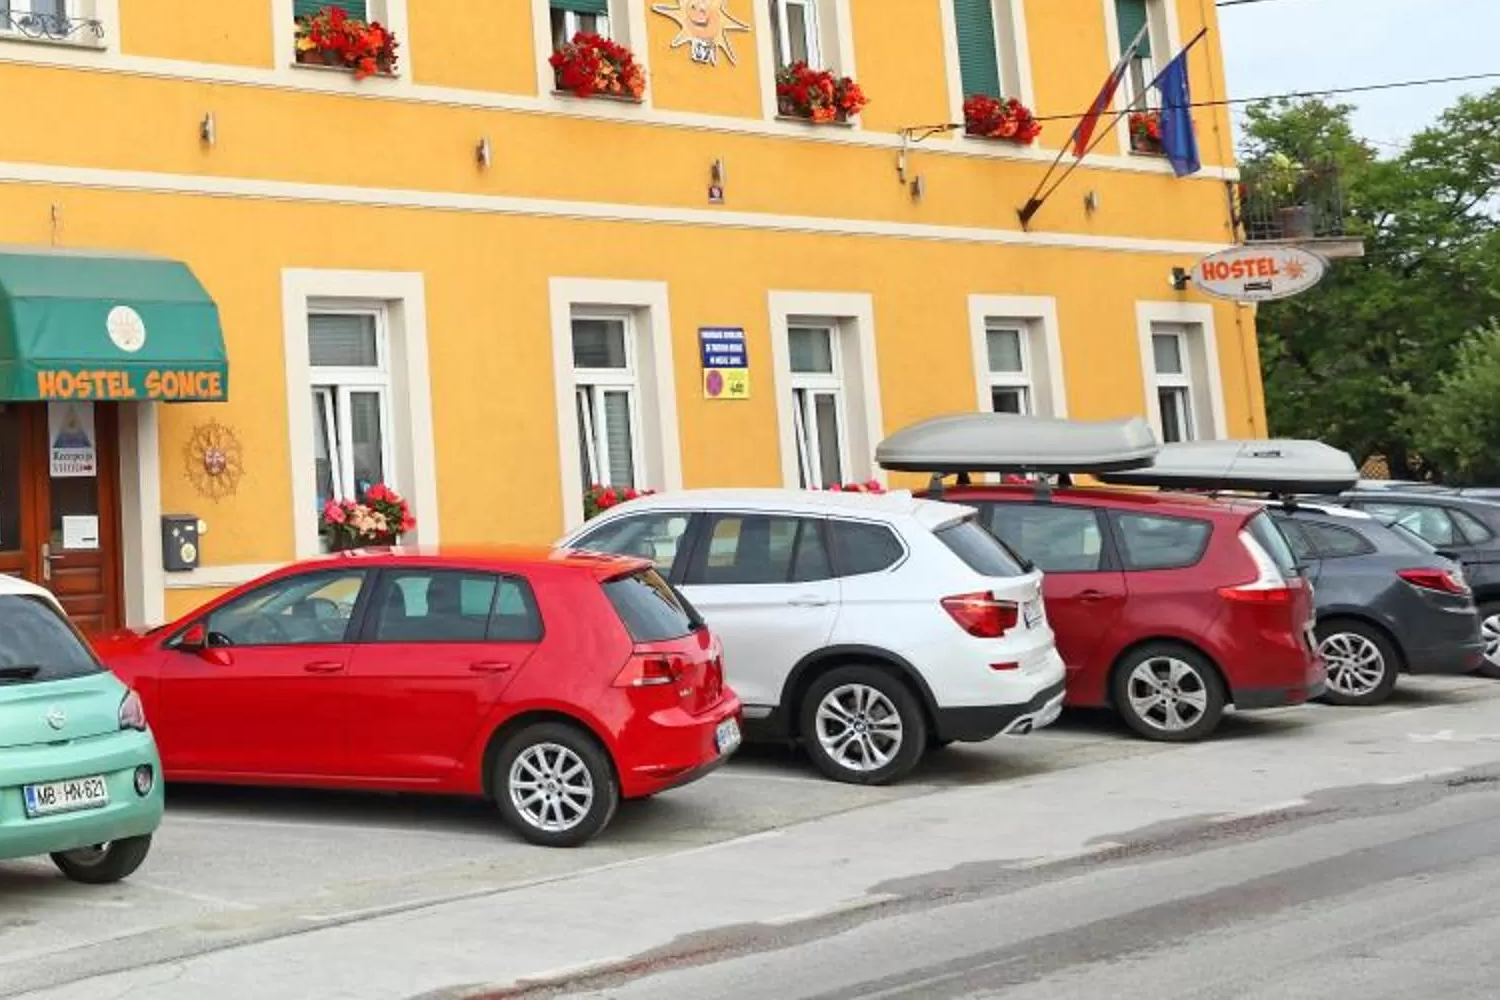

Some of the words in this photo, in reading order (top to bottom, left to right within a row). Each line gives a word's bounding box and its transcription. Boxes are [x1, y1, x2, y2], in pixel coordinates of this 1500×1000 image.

[1202, 258, 1279, 280] HOSTEL
[38, 371, 136, 398] HOSTEL
[145, 371, 221, 398] SONCE
